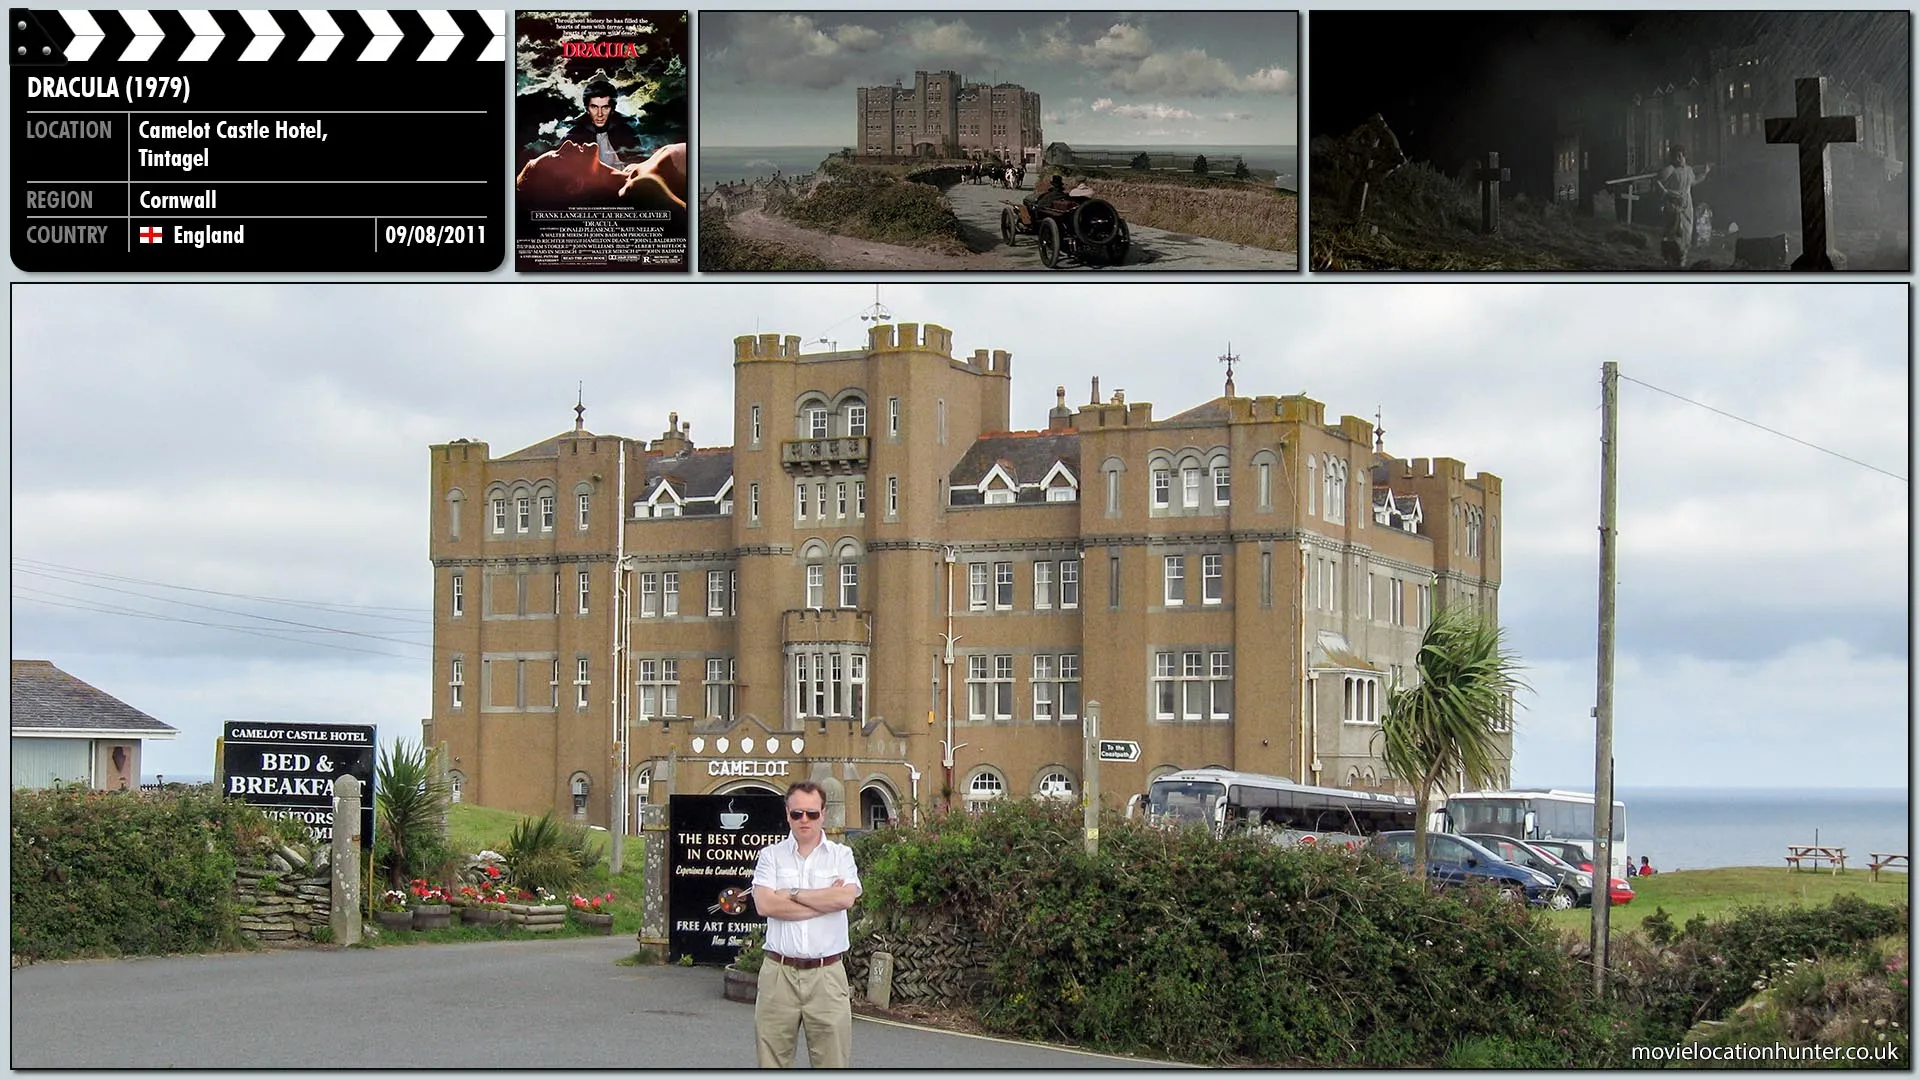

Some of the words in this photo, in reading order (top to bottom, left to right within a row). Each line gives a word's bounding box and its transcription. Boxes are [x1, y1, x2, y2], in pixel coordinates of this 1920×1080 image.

[562, 41, 640, 58] DRACULA
[231, 729, 285, 740] CAMELOT
[286, 730, 328, 741] CASTLE
[330, 731, 368, 742] HOTEL
[261, 753, 311, 772] BED
[316, 754, 335, 773] &
[708, 760, 790, 777] CAMELOT
[230, 775, 367, 798] BREAKFAT
[678, 833, 703, 845] THE
[707, 833, 737, 845] BEST
[687, 848, 701, 860] IN
[706, 848, 761, 861] CORNWA
[676, 920, 700, 932] FREE
[702, 921, 724, 932] ART
